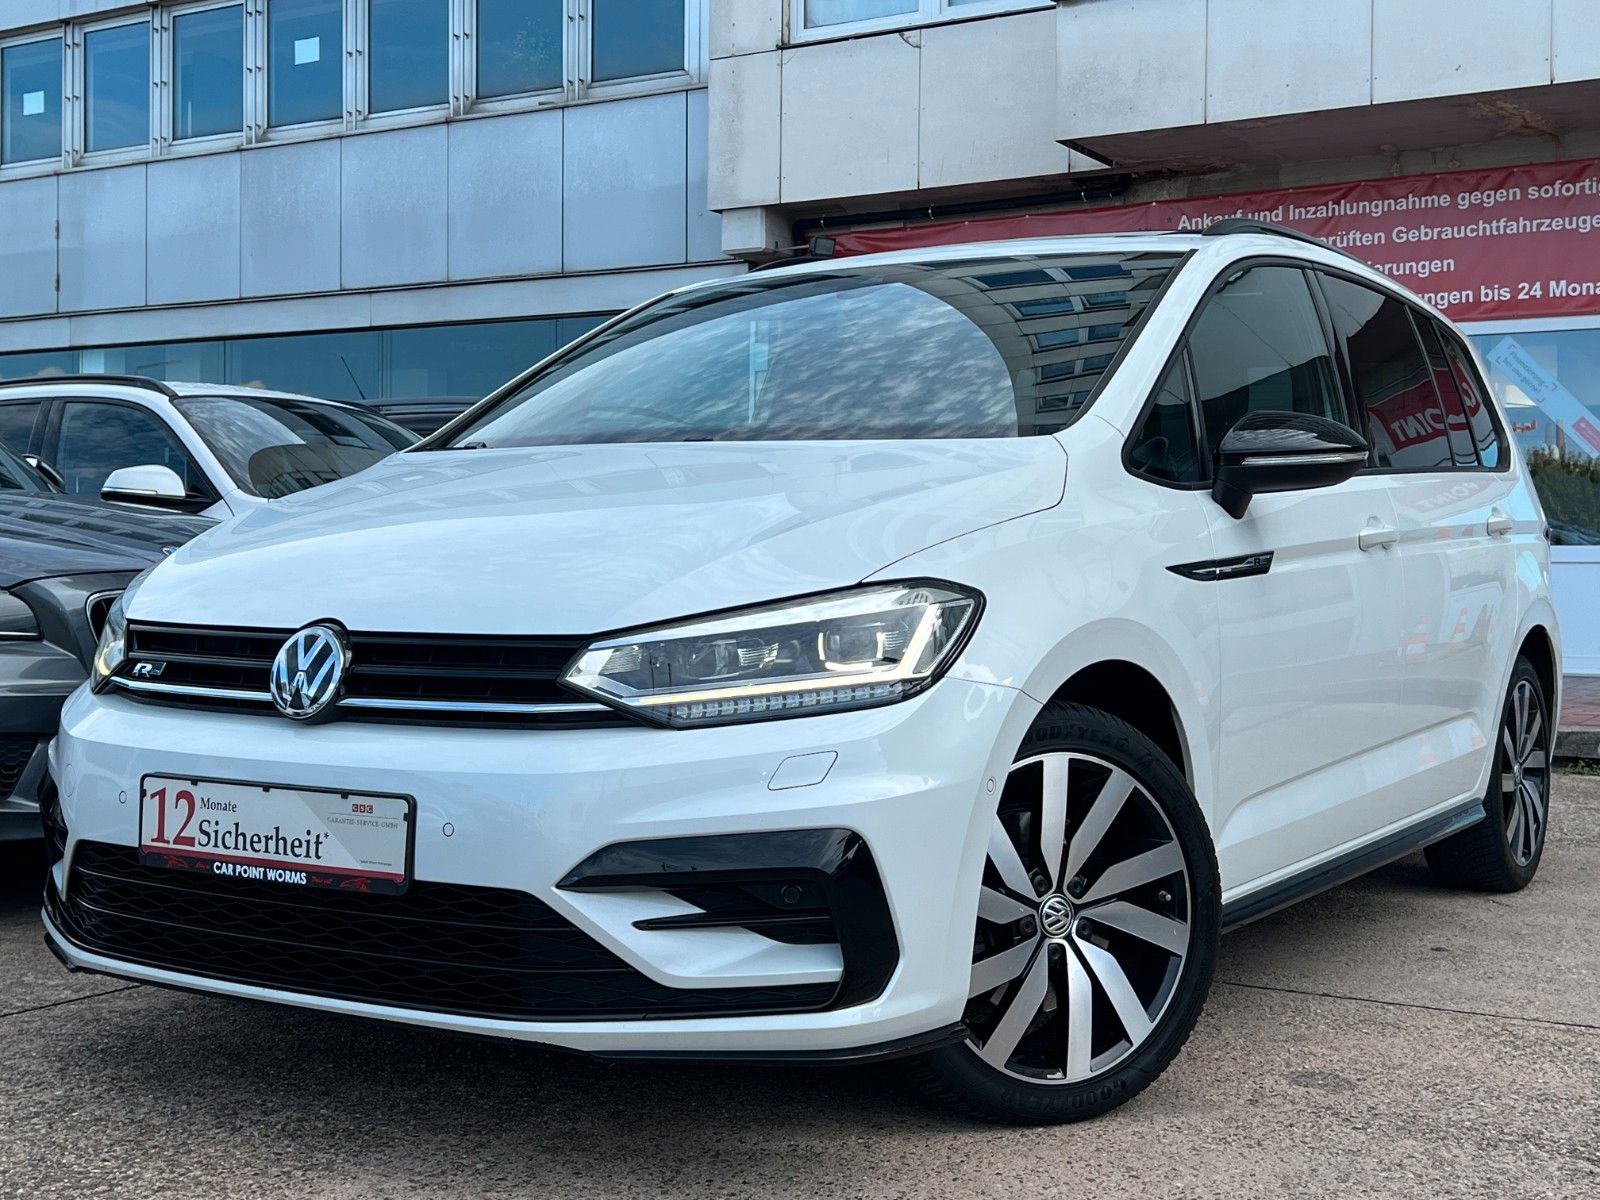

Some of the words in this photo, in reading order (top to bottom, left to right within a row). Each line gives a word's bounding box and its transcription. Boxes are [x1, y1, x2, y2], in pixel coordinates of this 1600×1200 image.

[1289, 194, 1450, 220] Inzahlungnahme
[1457, 187, 1521, 209] gegen
[1528, 177, 1600, 198] soforti
[1418, 290, 1474, 308] ngen
[1480, 285, 1511, 302] bis
[1518, 281, 1542, 299] 24
[150, 787, 196, 847] 12
[200, 797, 237, 813] Monate
[213, 861, 234, 876] CAR
[236, 864, 264, 880] POINT
[267, 868, 307, 884] WORMS
